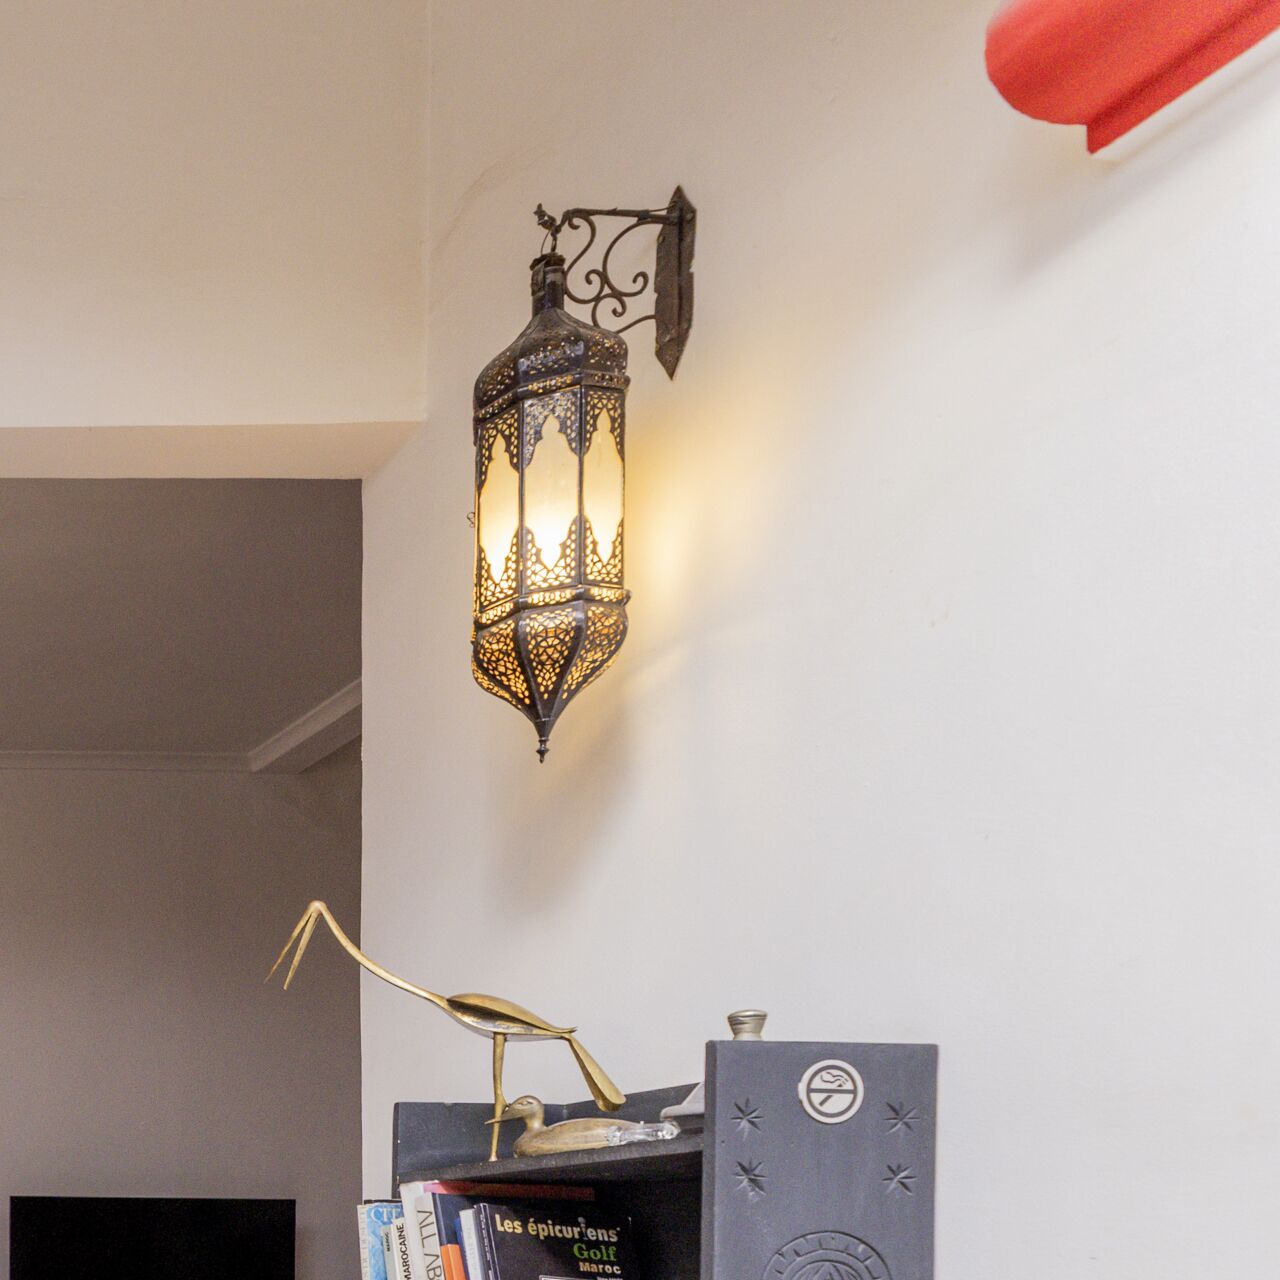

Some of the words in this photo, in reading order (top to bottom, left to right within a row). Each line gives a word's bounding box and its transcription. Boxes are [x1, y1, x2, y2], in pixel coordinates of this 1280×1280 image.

[416, 1209, 437, 1243] ALL
[494, 1213, 523, 1234] Les
[527, 1217, 618, 1242] épicuriens
[573, 1242, 617, 1261] Golf
[579, 1261, 622, 1274] Maroc
